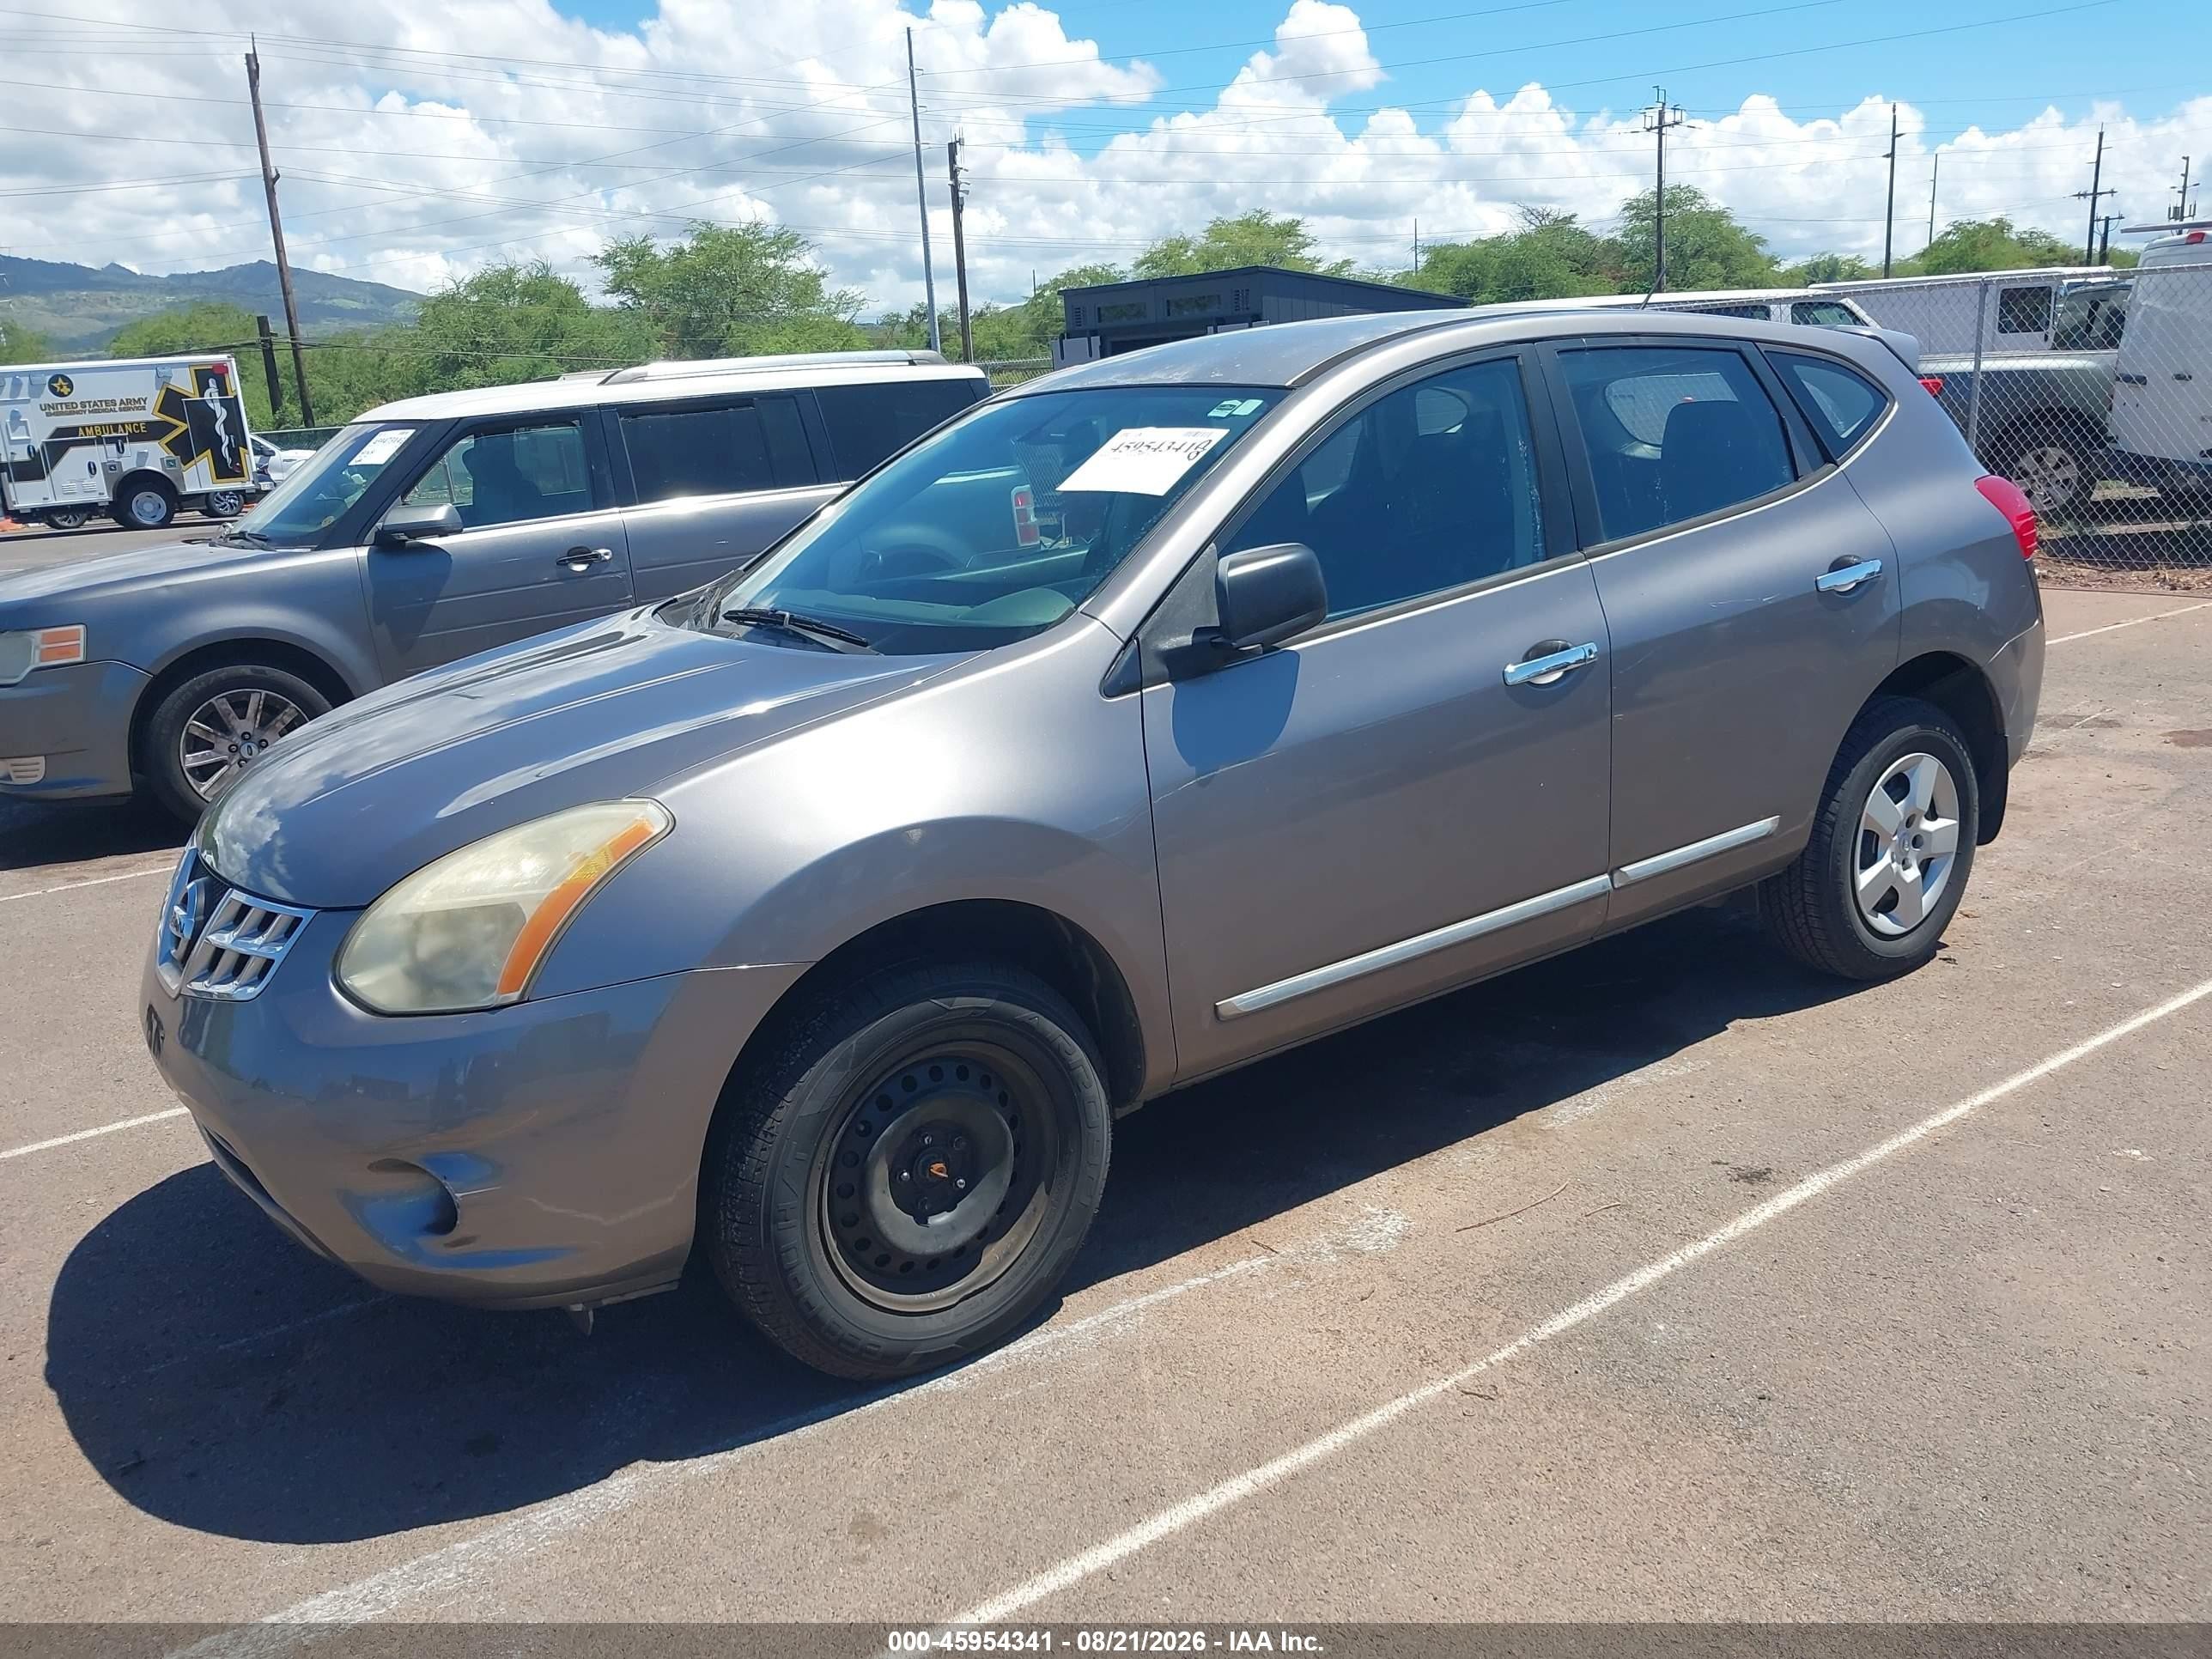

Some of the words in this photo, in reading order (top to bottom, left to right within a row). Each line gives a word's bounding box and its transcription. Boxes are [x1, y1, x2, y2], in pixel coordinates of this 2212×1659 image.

[40, 401, 78, 411] UNITED
[80, 398, 117, 409] STATES
[118, 397, 148, 406] ARMY
[46, 409, 87, 417] EMERGENCY
[78, 422, 148, 437] AMBULANCE
